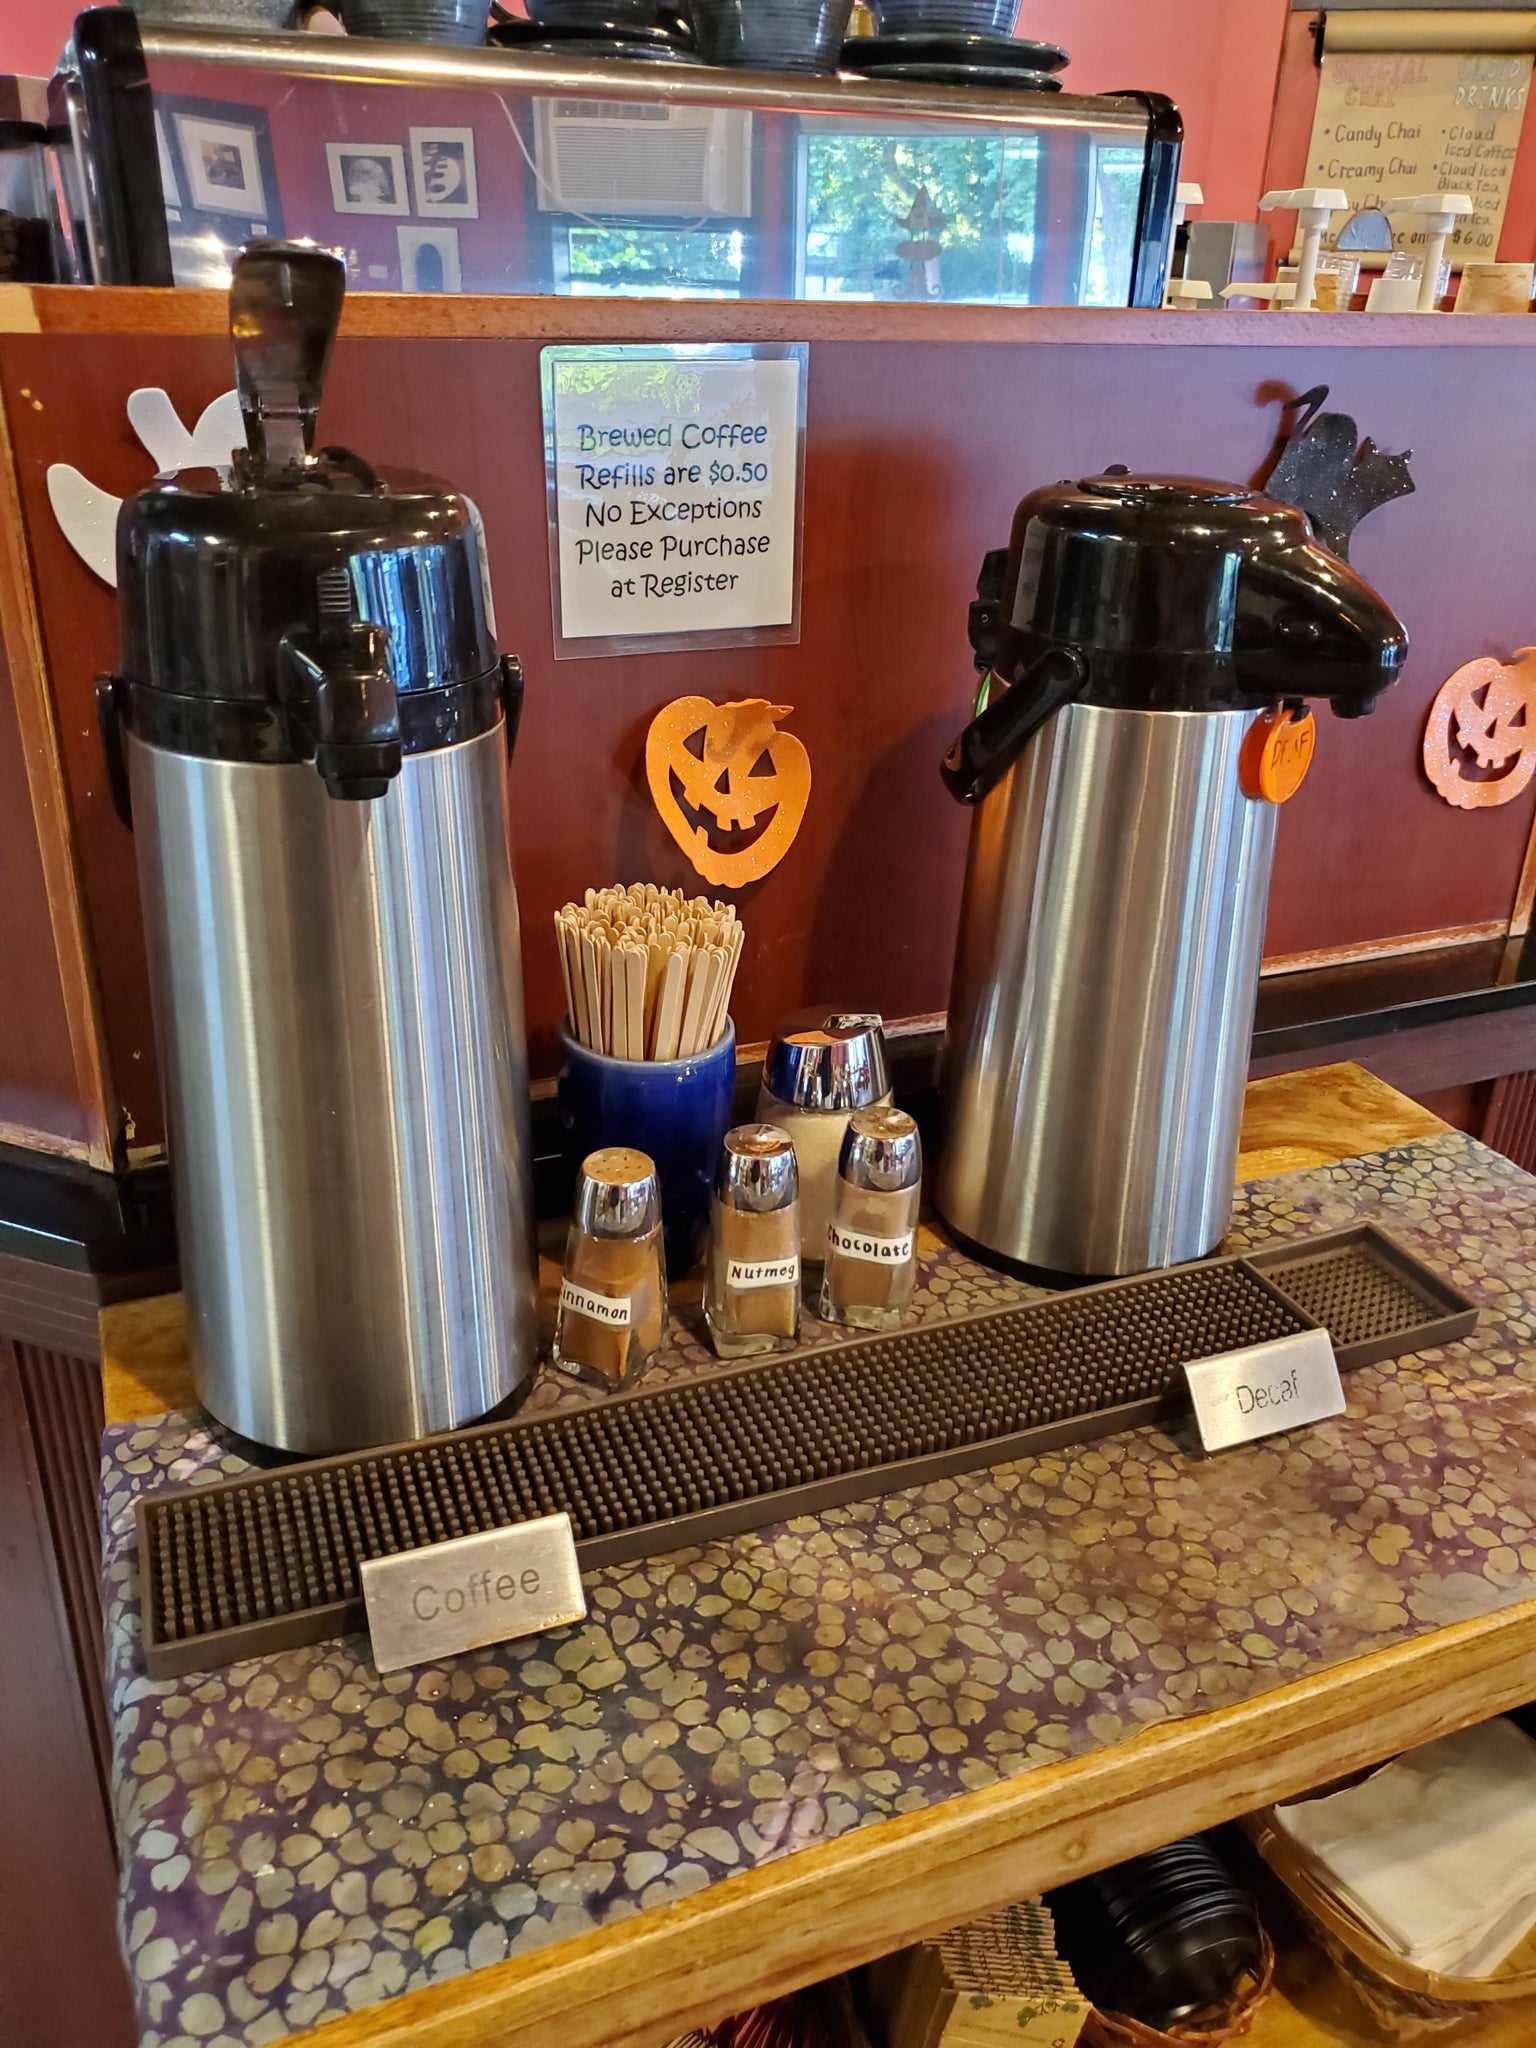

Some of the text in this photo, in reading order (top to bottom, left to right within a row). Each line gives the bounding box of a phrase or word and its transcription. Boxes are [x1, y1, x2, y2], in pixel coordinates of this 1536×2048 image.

[1453, 84, 1526, 111] DRINKS
[1335, 121, 1421, 148] Candy Chai
[1449, 124, 1496, 141] Cloud
[1444, 143, 1517, 160] Iced Coffee
[1328, 156, 1418, 184] Creamy Chai
[1439, 161, 1507, 177] Cloud Iced
[1437, 177, 1501, 194] Black Tea
[577, 423, 768, 451] Brewed Coffee
[575, 460, 768, 490] Refills are $0.50
[585, 497, 763, 528] No Exceptions
[575, 534, 771, 565] Please Purchase
[611, 571, 739, 598] at Register
[731, 1263, 796, 1281] Nutmeg
[562, 1284, 628, 1321] innamon
[1236, 1369, 1300, 1414] Decaf
[412, 1568, 541, 1622] Coffee
